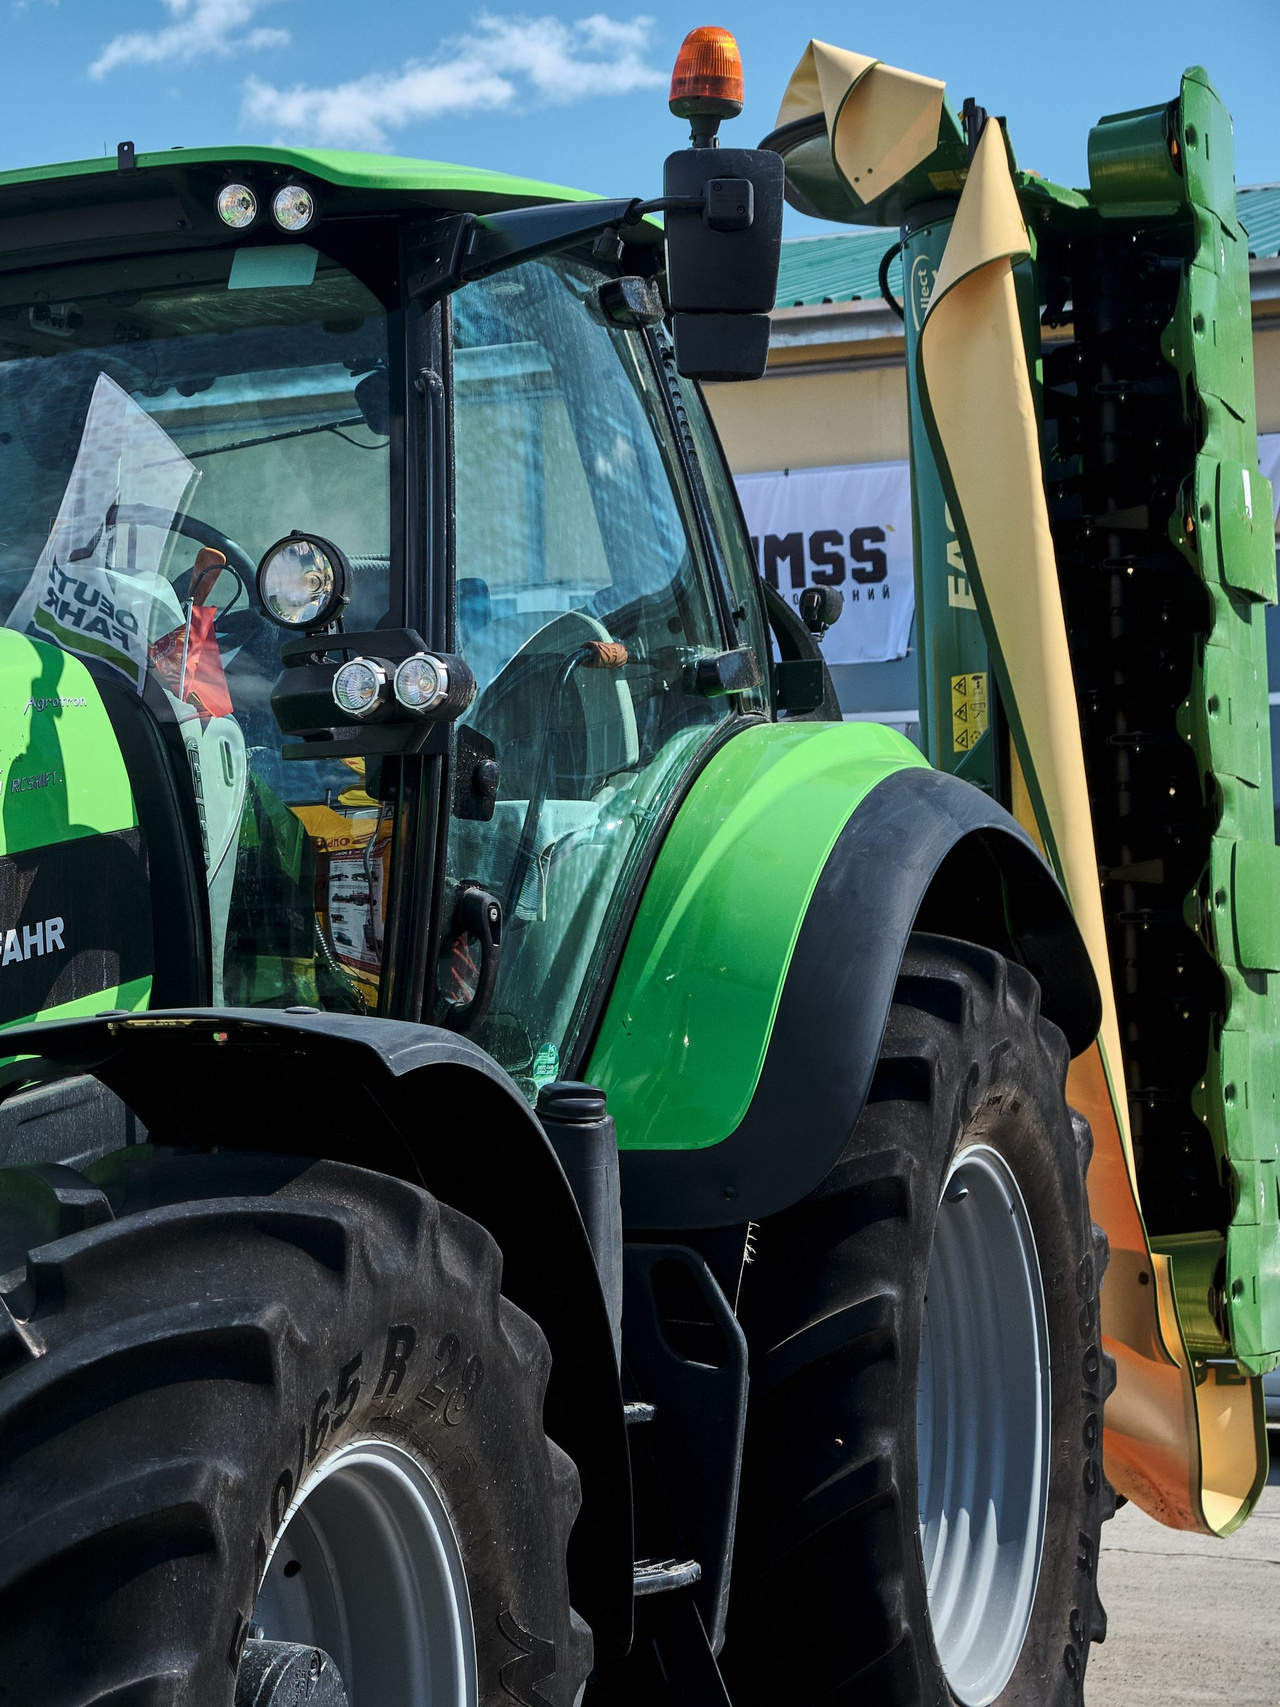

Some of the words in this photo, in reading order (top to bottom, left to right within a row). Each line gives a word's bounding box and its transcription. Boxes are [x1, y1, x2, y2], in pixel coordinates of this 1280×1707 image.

[22, 696, 88, 716] Agrotron
[371, 1323, 418, 1401] R
[416, 1331, 485, 1427] 28
